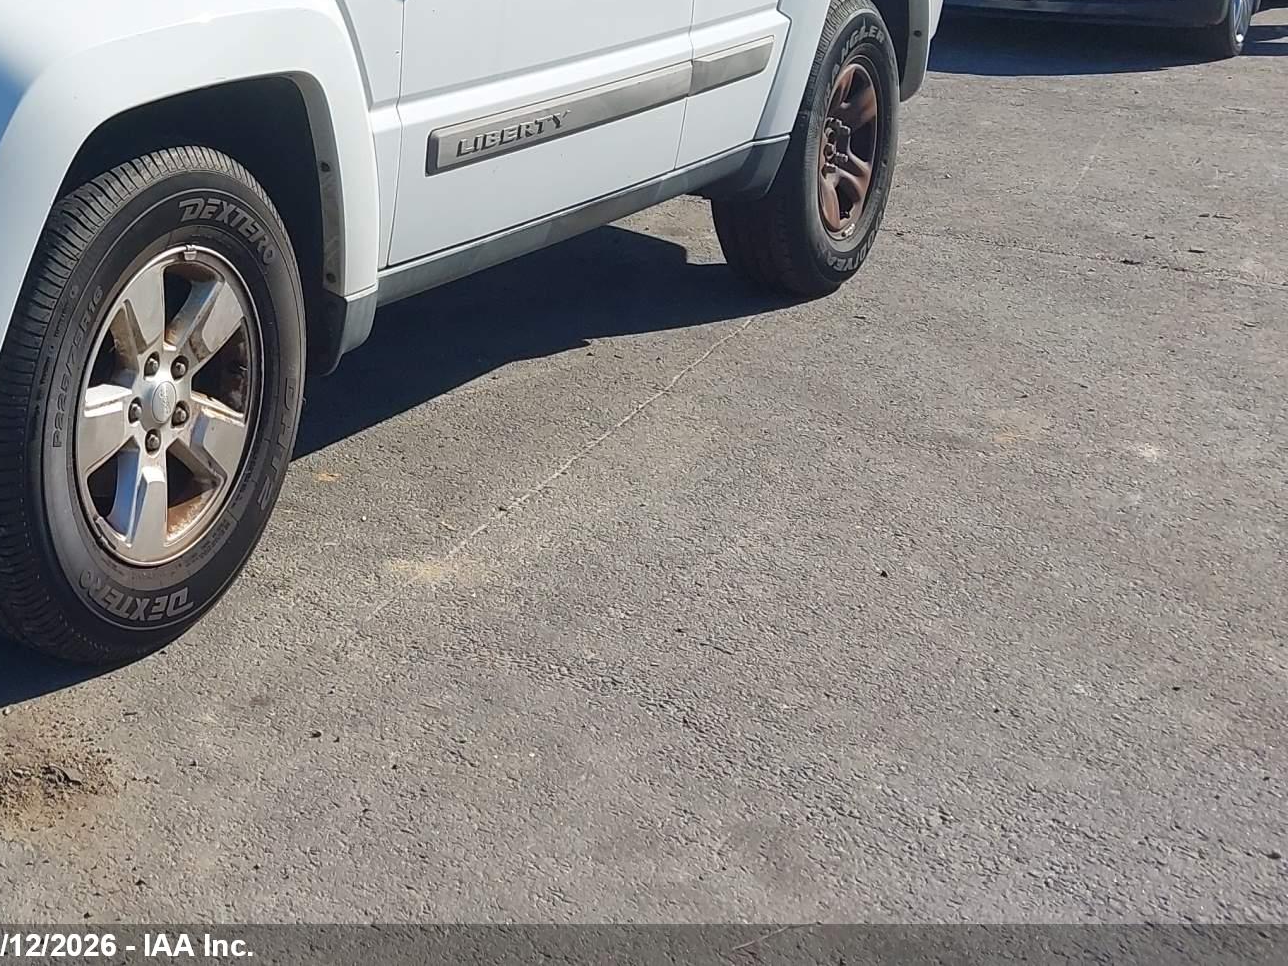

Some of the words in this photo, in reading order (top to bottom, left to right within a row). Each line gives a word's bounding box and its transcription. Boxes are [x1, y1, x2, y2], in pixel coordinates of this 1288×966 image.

[456, 109, 571, 157] LIBERTY
[178, 197, 277, 265] DEXTERO
[79, 569, 194, 622] DEXTERO
